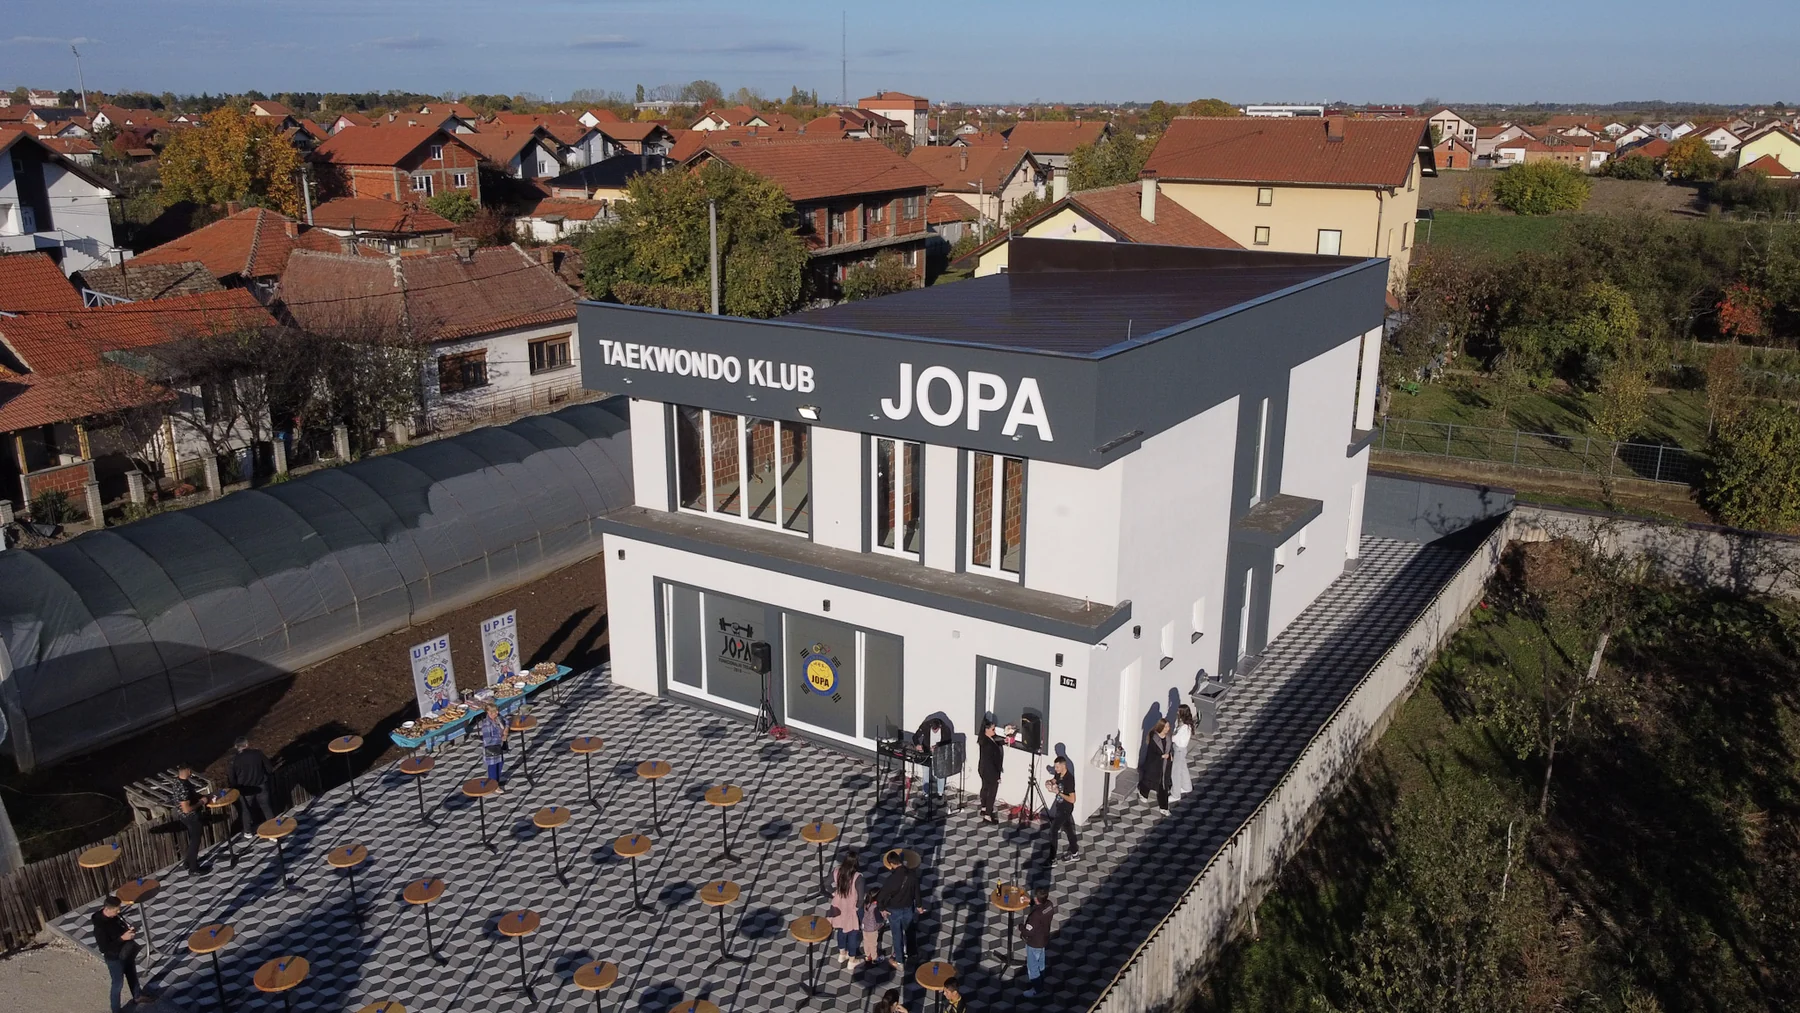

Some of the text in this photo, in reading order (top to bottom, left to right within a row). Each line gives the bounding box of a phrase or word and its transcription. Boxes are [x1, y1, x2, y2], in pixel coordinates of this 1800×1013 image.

[599, 339, 816, 394] TAEKWONDO KLUB
[880, 362, 1054, 442] JOPA
[483, 614, 514, 633] UPIS
[413, 639, 447, 659] UPIS
[721, 635, 752, 663] JOPA
[811, 674, 830, 688] JOPA
